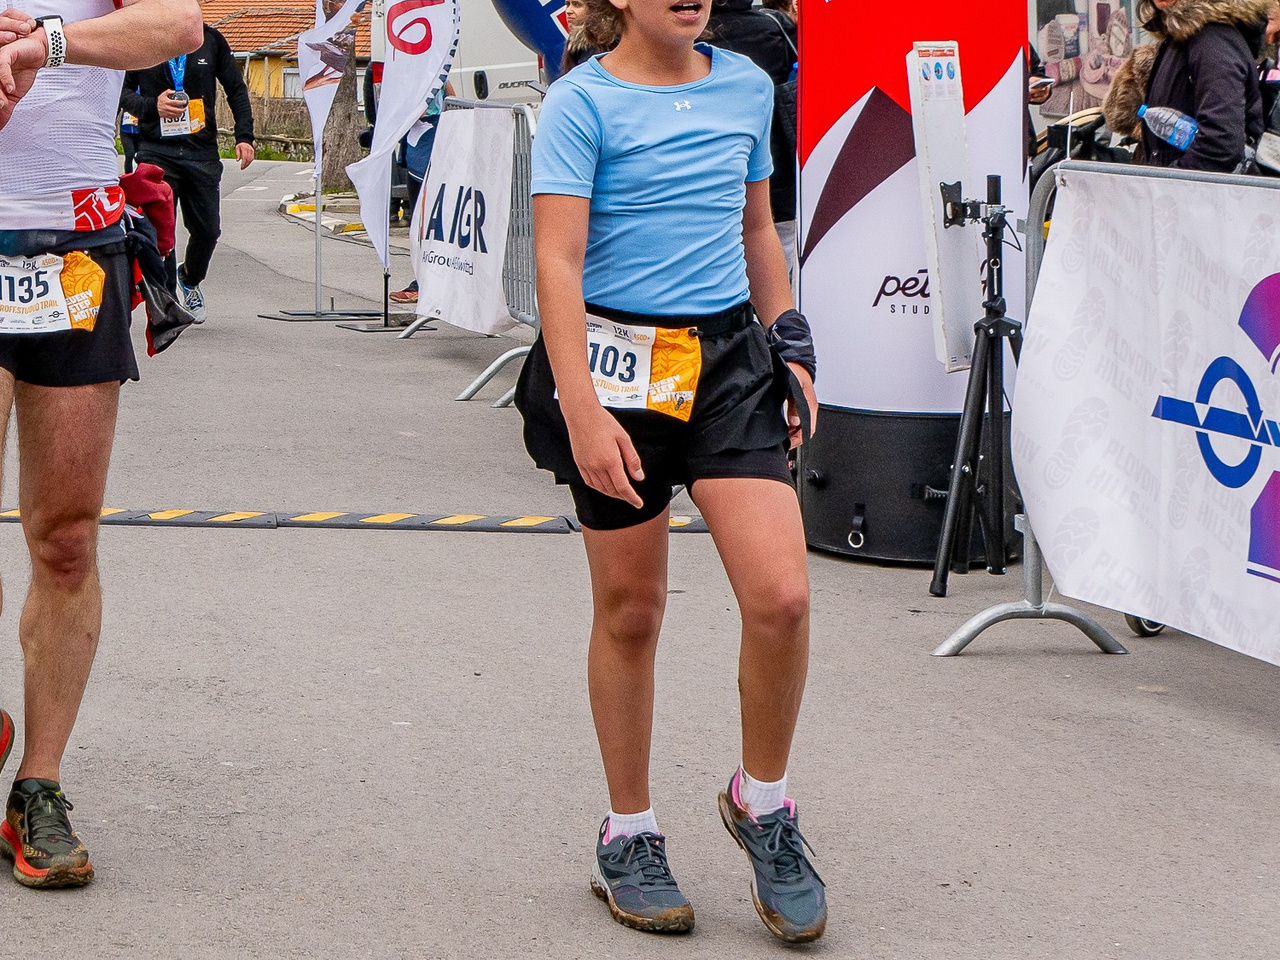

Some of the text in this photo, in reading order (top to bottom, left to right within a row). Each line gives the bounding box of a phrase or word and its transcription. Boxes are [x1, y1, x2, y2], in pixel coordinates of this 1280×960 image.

[498, 80, 535, 89] DUCAT
[41, 300, 59, 310] TRAIL
[890, 305, 930, 314] STUD
[613, 325, 629, 338] 12K
